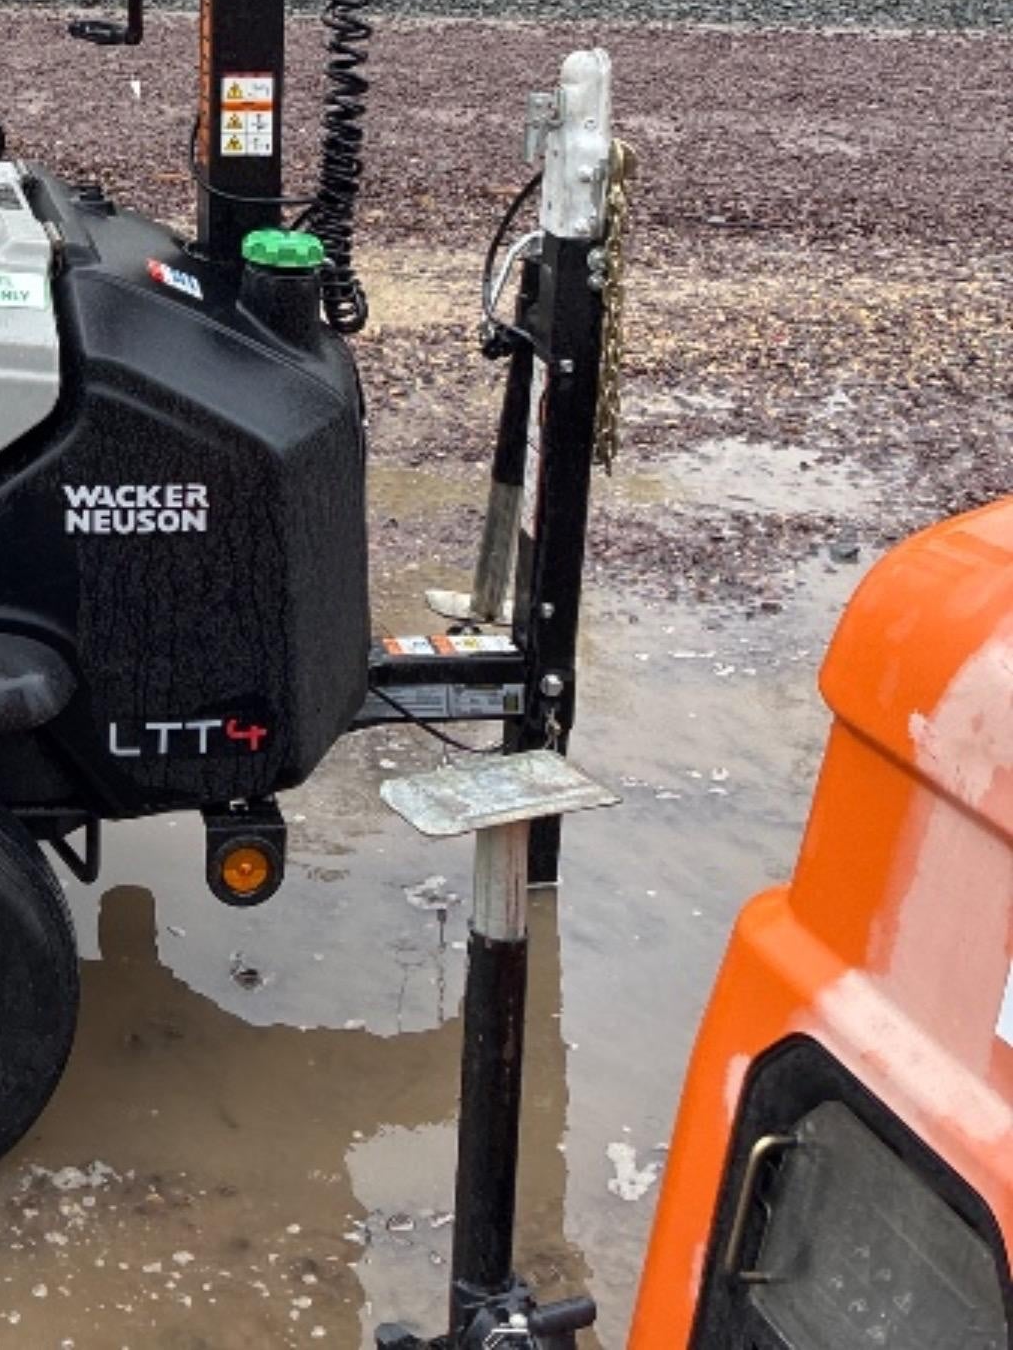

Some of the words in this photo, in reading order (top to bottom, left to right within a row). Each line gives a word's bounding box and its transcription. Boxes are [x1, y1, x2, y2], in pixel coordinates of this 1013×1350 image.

[62, 482, 210, 508] WACKER
[65, 508, 208, 534] NEUSON
[109, 718, 267, 756] LTT4
